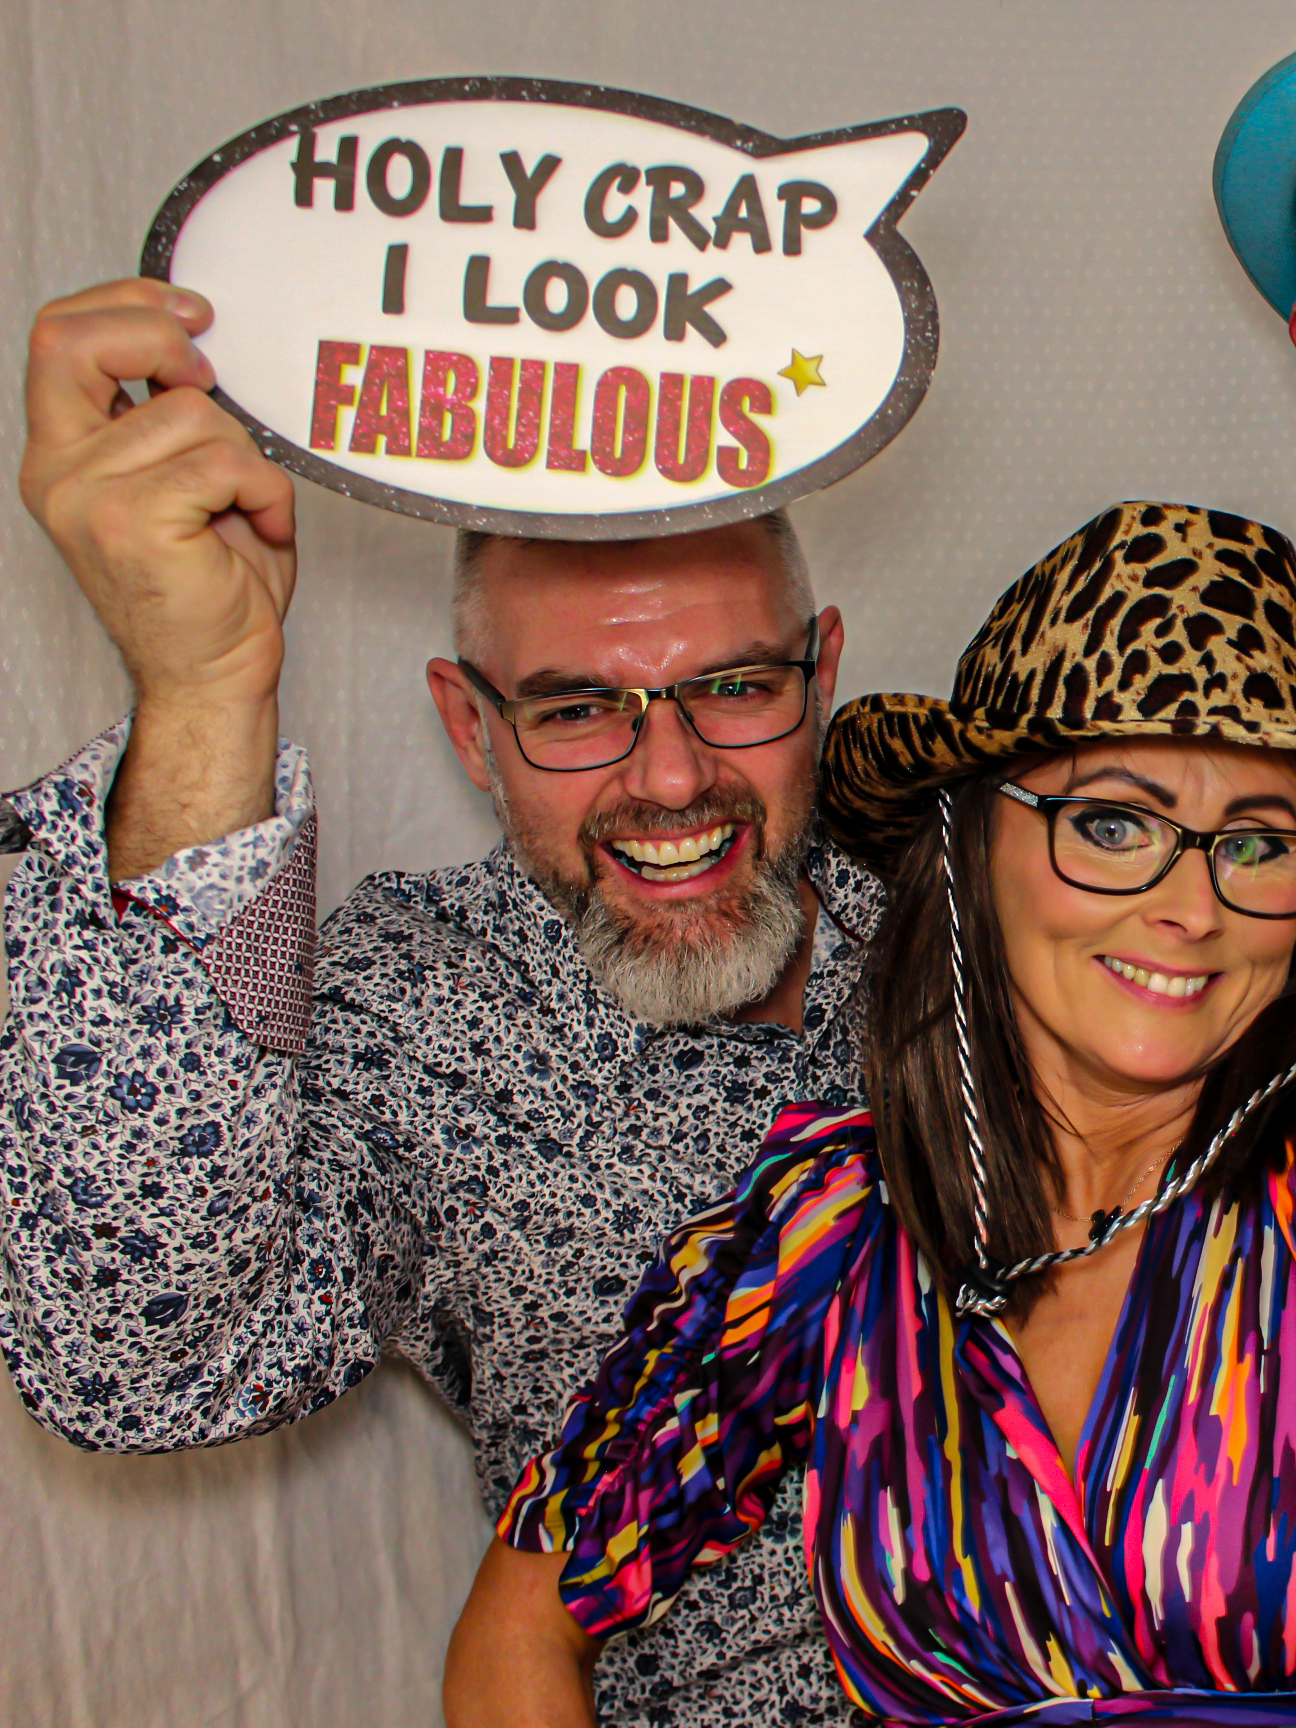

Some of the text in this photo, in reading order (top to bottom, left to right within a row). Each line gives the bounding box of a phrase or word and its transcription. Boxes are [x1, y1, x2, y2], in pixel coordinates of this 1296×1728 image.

[290, 128, 838, 257] HOLY CRAP
[382, 243, 732, 348] I LOOK
[309, 338, 775, 489] FABULOUS
